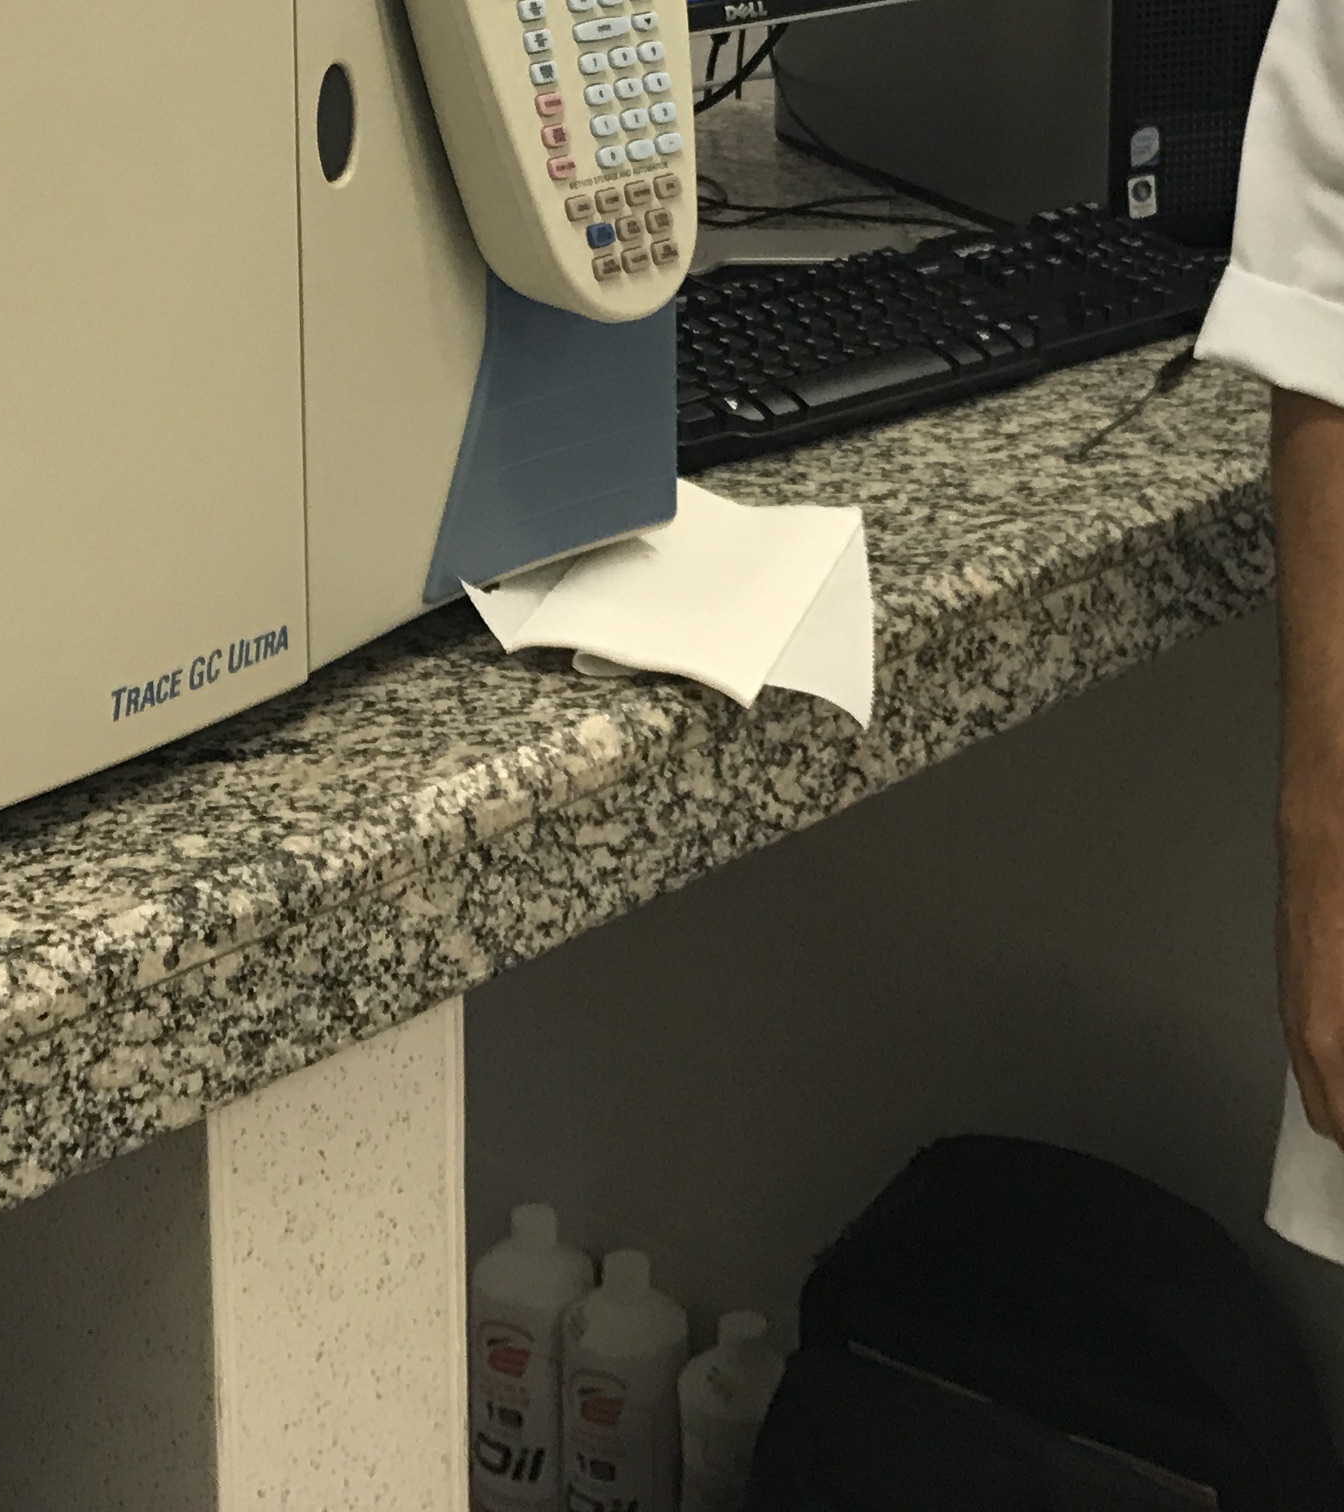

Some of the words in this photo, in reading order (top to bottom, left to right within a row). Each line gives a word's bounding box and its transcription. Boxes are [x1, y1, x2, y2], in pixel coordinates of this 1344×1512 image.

[724, 0, 768, 22] DELL
[111, 668, 183, 722] TRACE
[189, 648, 222, 690] GC
[228, 624, 288, 674] ULTRA
